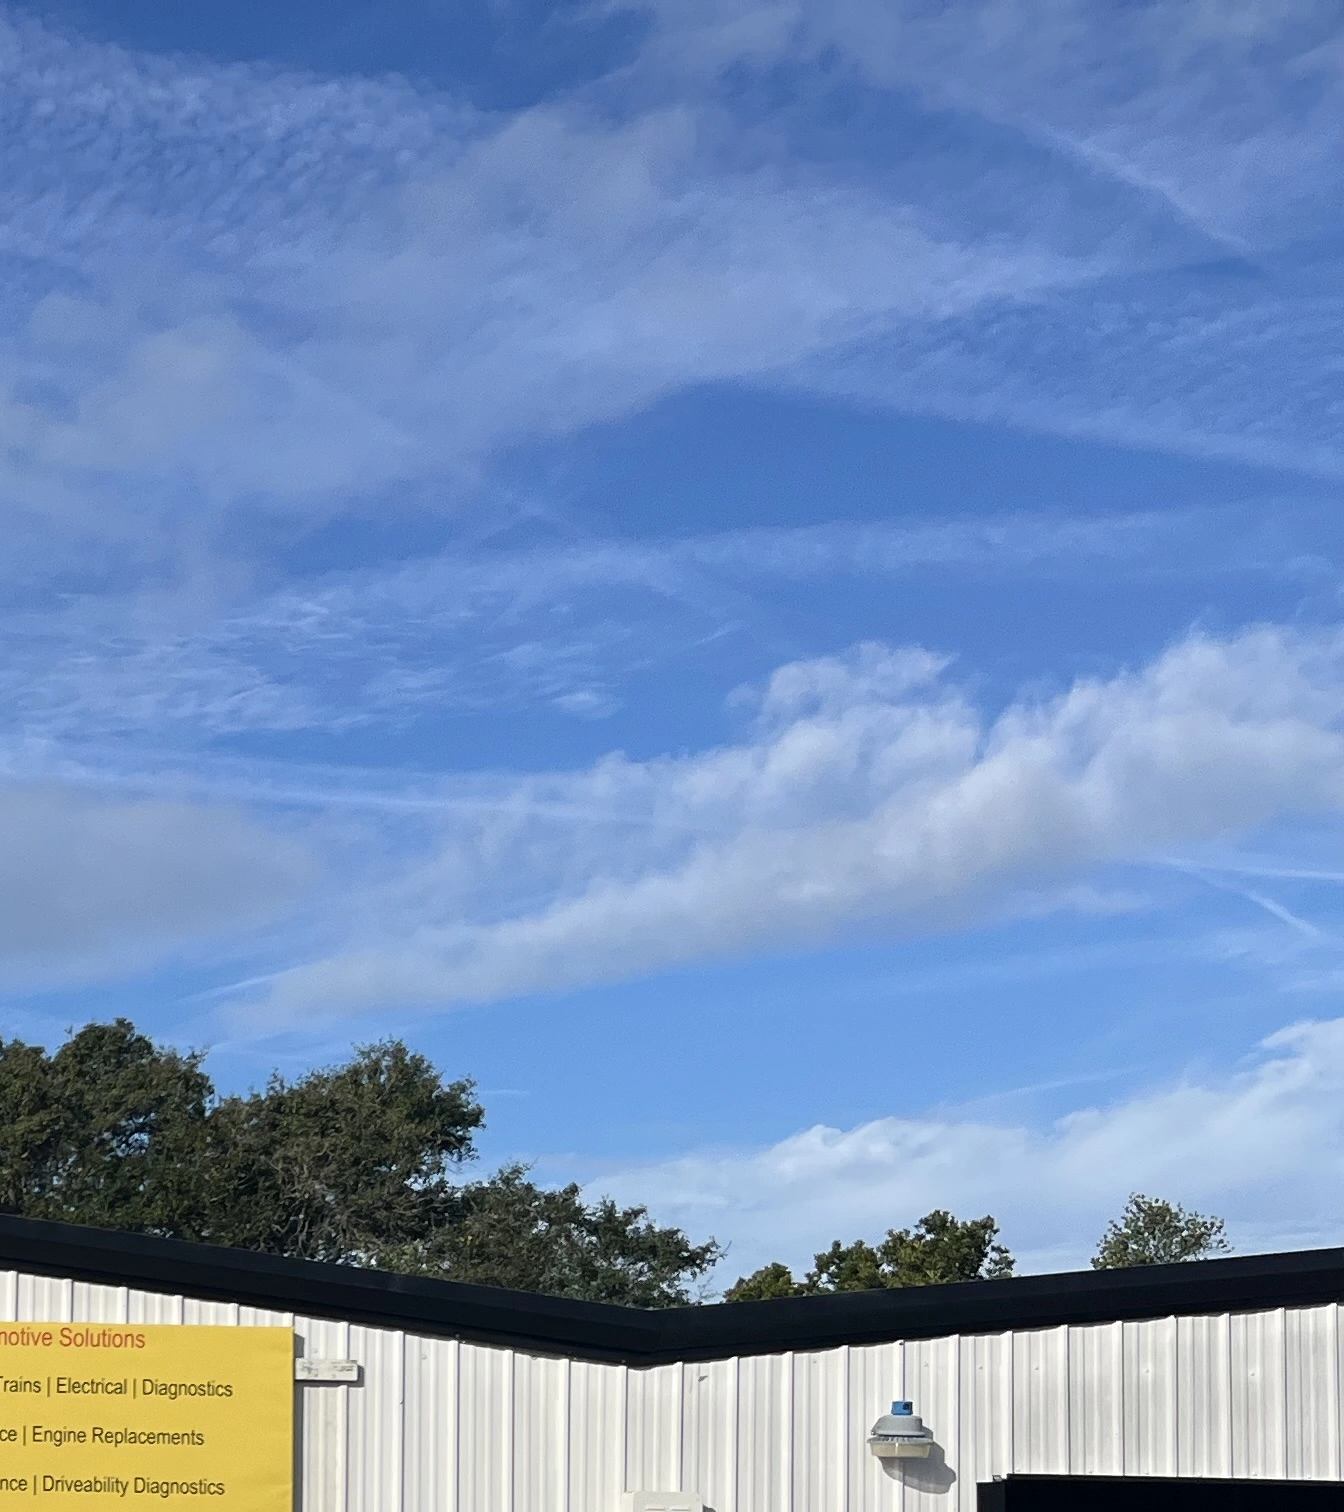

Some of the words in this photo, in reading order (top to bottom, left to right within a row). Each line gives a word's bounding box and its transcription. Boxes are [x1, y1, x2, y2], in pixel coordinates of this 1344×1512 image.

[60, 1328, 144, 1348] Solutions
[57, 1377, 126, 1394] Electrical
[143, 1379, 232, 1399] Diagnostics
[33, 1426, 86, 1446] Engine
[93, 1427, 204, 1447] Replacements
[43, 1476, 128, 1497] Driveability
[135, 1477, 224, 1498] Diagnostics
